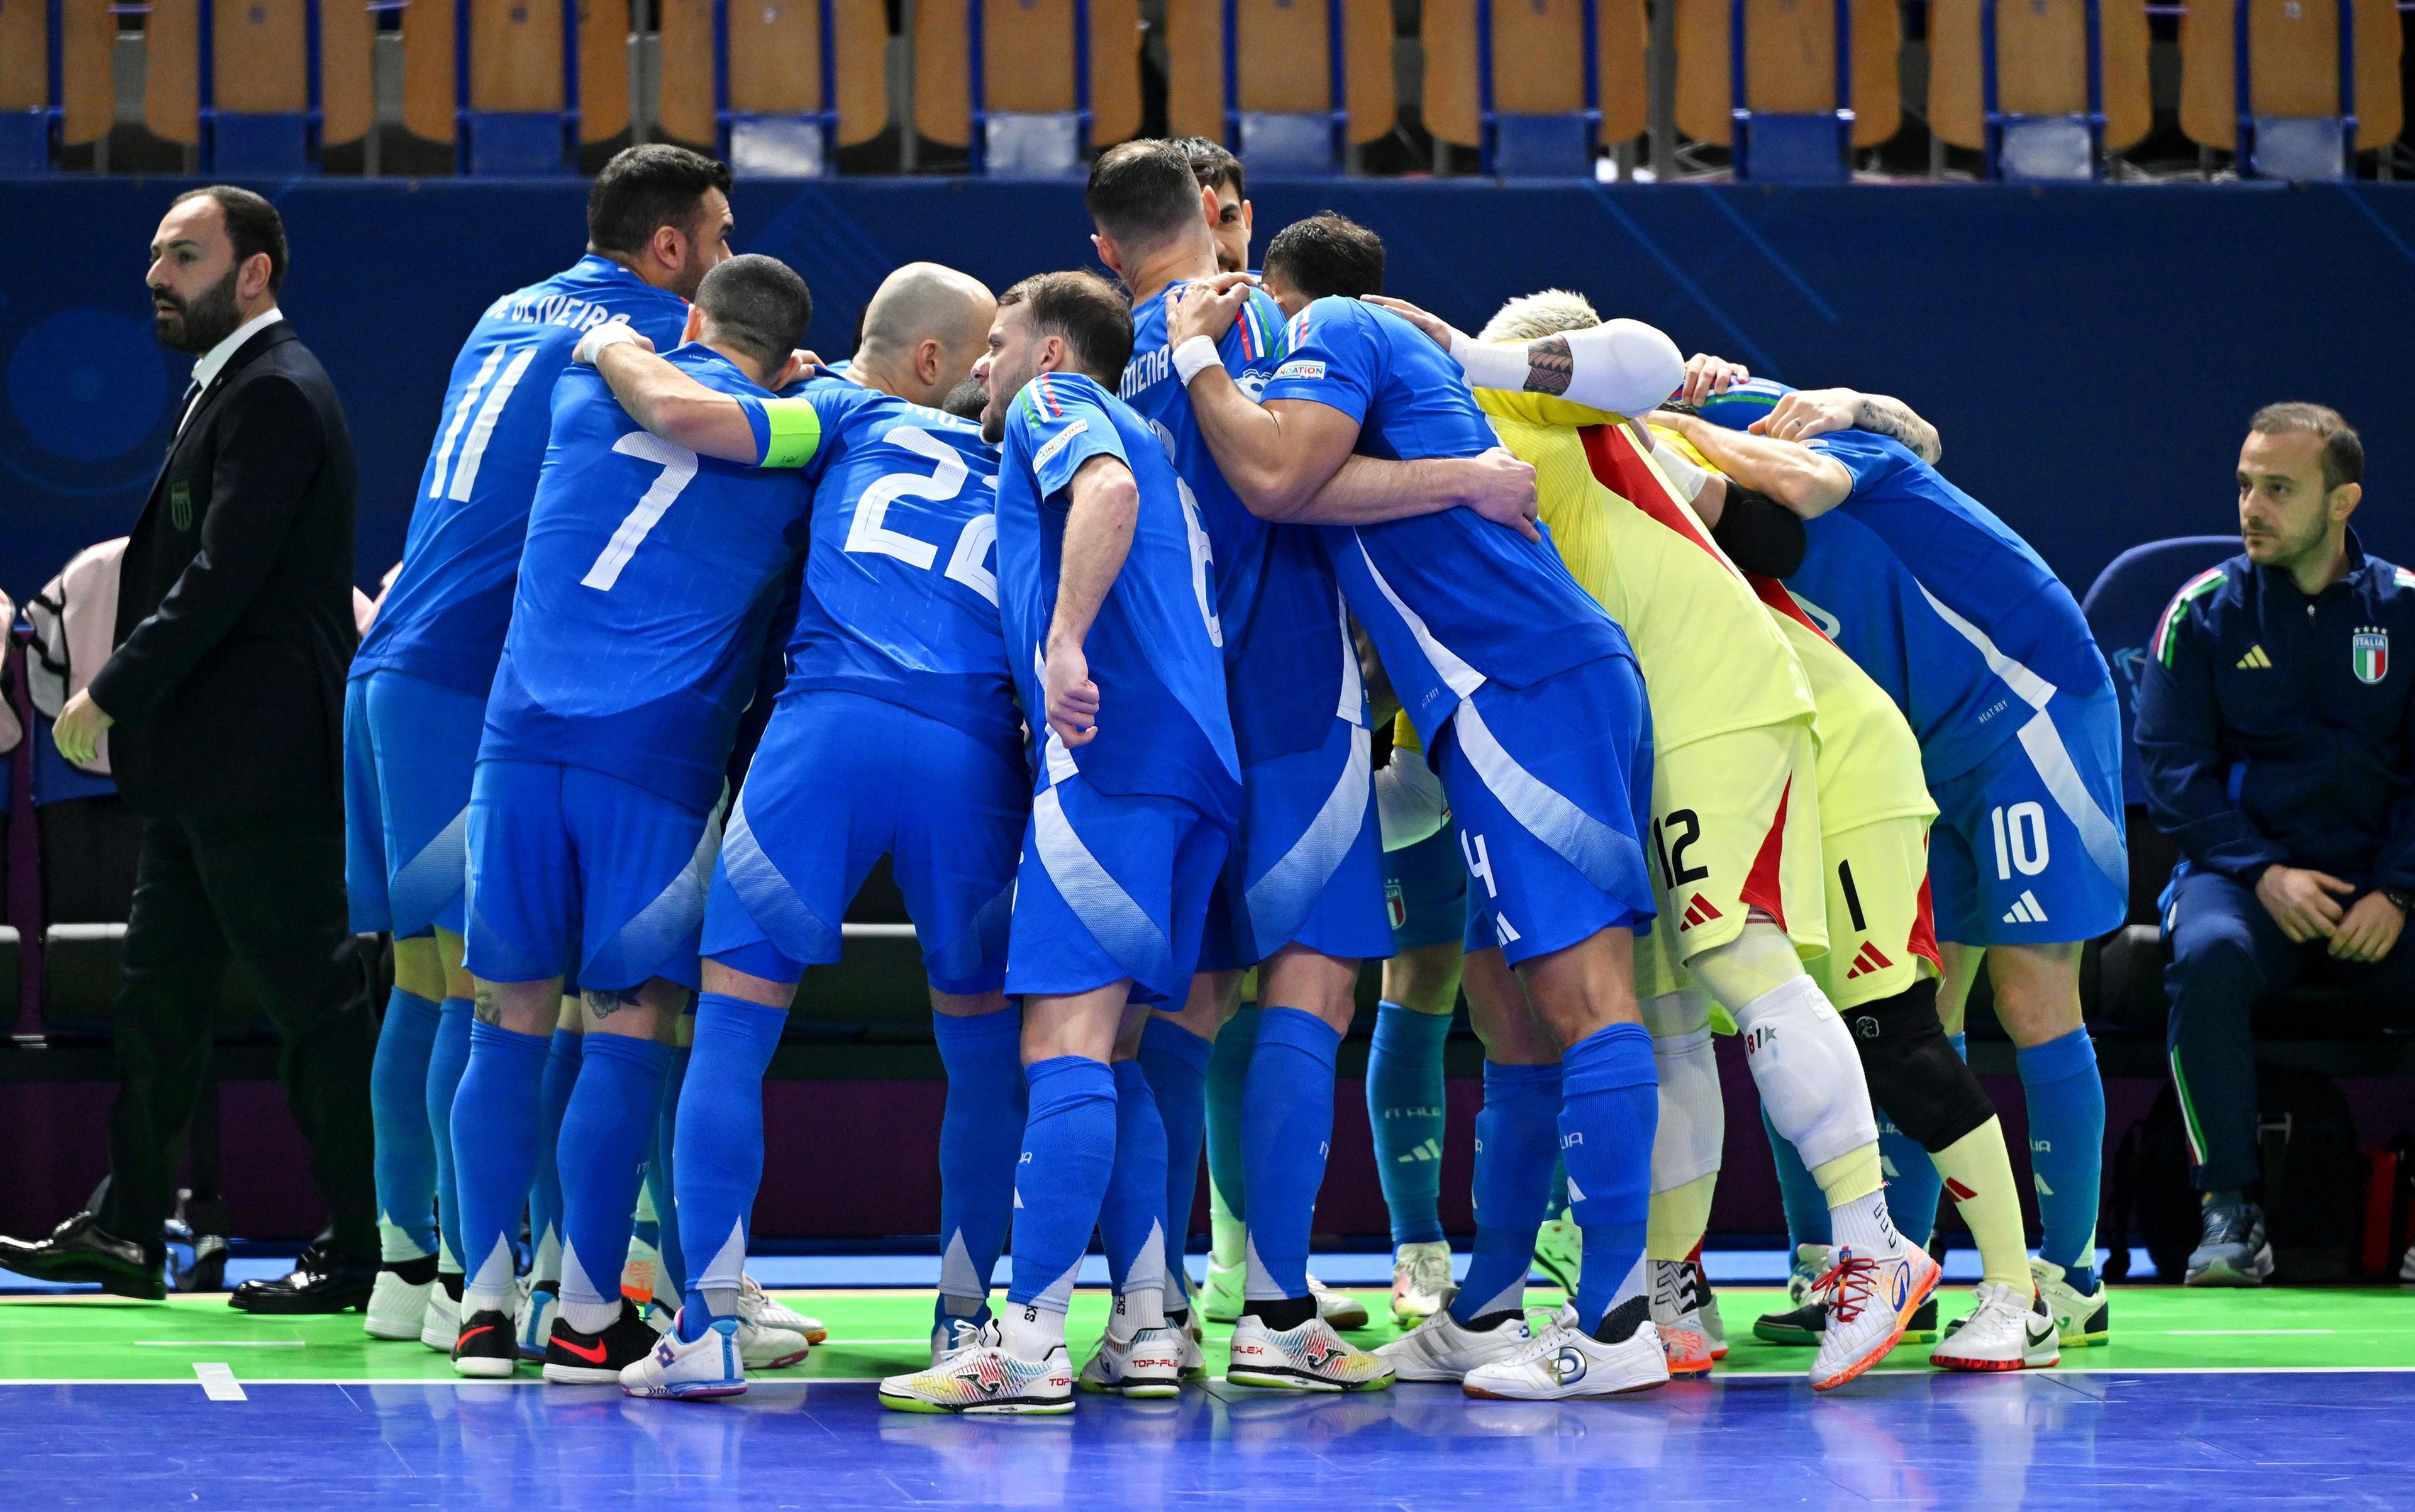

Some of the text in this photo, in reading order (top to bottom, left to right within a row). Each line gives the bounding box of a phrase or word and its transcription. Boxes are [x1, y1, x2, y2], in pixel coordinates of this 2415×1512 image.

[429, 343, 539, 503] 11
[580, 431, 699, 592] 7
[2356, 636, 2385, 647] ITALIA
[1978, 699, 2007, 724] HEAT.RDY
[1461, 828, 1497, 899] 4
[1653, 809, 1709, 891] 12
[1991, 801, 2050, 881] 10
[1838, 859, 1867, 933] 1
[1745, 1028, 1762, 1058] 81
[1560, 1132, 1583, 1150] LIA
[1132, 1359, 1178, 1368] TOP-FLE
[1231, 1346, 1264, 1355] -FLEX
